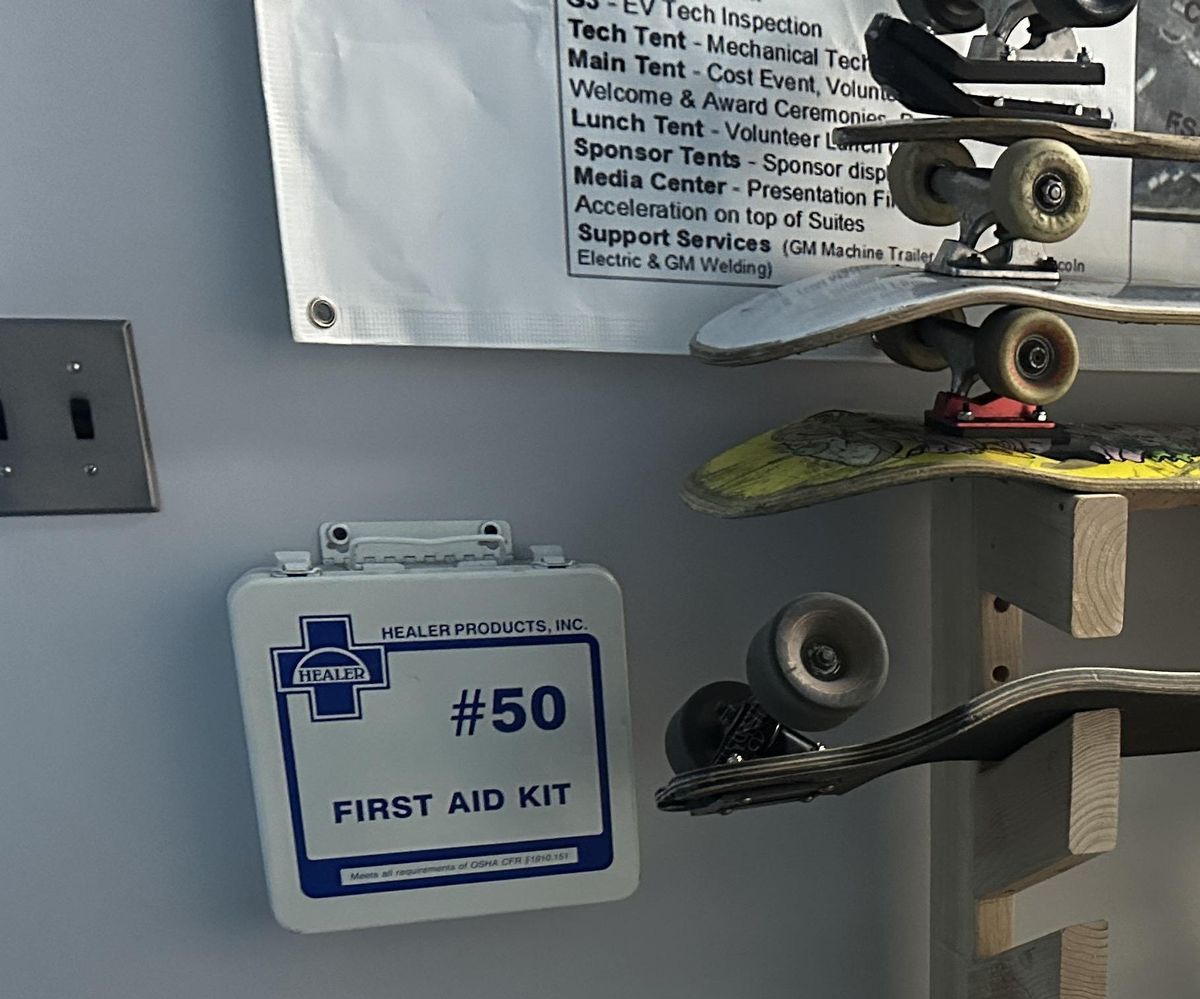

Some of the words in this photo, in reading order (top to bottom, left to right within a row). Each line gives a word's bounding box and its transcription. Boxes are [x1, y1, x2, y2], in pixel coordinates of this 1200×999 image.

[623, 0, 655, 15] EV
[661, 0, 716, 23] Tech
[722, 6, 823, 37] Inspection
[568, 18, 626, 43] Tech
[634, 26, 686, 50] Tent
[707, 34, 818, 66] Mechanical
[568, 48, 626, 73] Main
[635, 55, 686, 78] Tent
[707, 63, 753, 86] Cost
[760, 69, 821, 97] Event,
[826, 76, 896, 102] Volunt
[569, 78, 673, 107] Welcome
[680, 89, 696, 108] &
[702, 92, 767, 116] Award
[571, 108, 645, 133] Lunch
[654, 115, 704, 137] Tent
[725, 121, 820, 148] Volunteer
[574, 137, 673, 161] Sponsor
[680, 146, 741, 168] Tents
[762, 153, 843, 178] Sponsor
[574, 166, 643, 189] Media
[651, 172, 727, 195] Center
[747, 178, 867, 206] Presentation
[873, 189, 895, 208] Fi
[575, 195, 707, 221] Acceleration
[714, 207, 739, 223] on
[746, 207, 777, 229] top
[784, 210, 803, 228] of
[809, 211, 865, 232] Suites
[578, 223, 670, 248] Support
[677, 229, 771, 252] Services
[782, 239, 816, 258] (GM
[821, 241, 884, 260] Machine
[577, 249, 642, 269] Electric
[647, 253, 660, 269] &
[665, 254, 695, 271] GM
[701, 256, 773, 279] Welding)
[381, 625, 451, 641] HEALER
[454, 620, 552, 637] PRODUCTS,
[555, 618, 588, 632] INC.
[298, 666, 366, 683] HEALER
[450, 684, 567, 738] #50
[333, 794, 434, 825] FIRST
[447, 787, 505, 815] AID
[519, 783, 572, 809] KIT
[349, 870, 380, 882] Meets
[381, 869, 394, 879] all
[395, 863, 457, 878] requirements
[458, 861, 469, 871] of
[470, 857, 499, 870] OSHA
[501, 856, 522, 867] CFR
